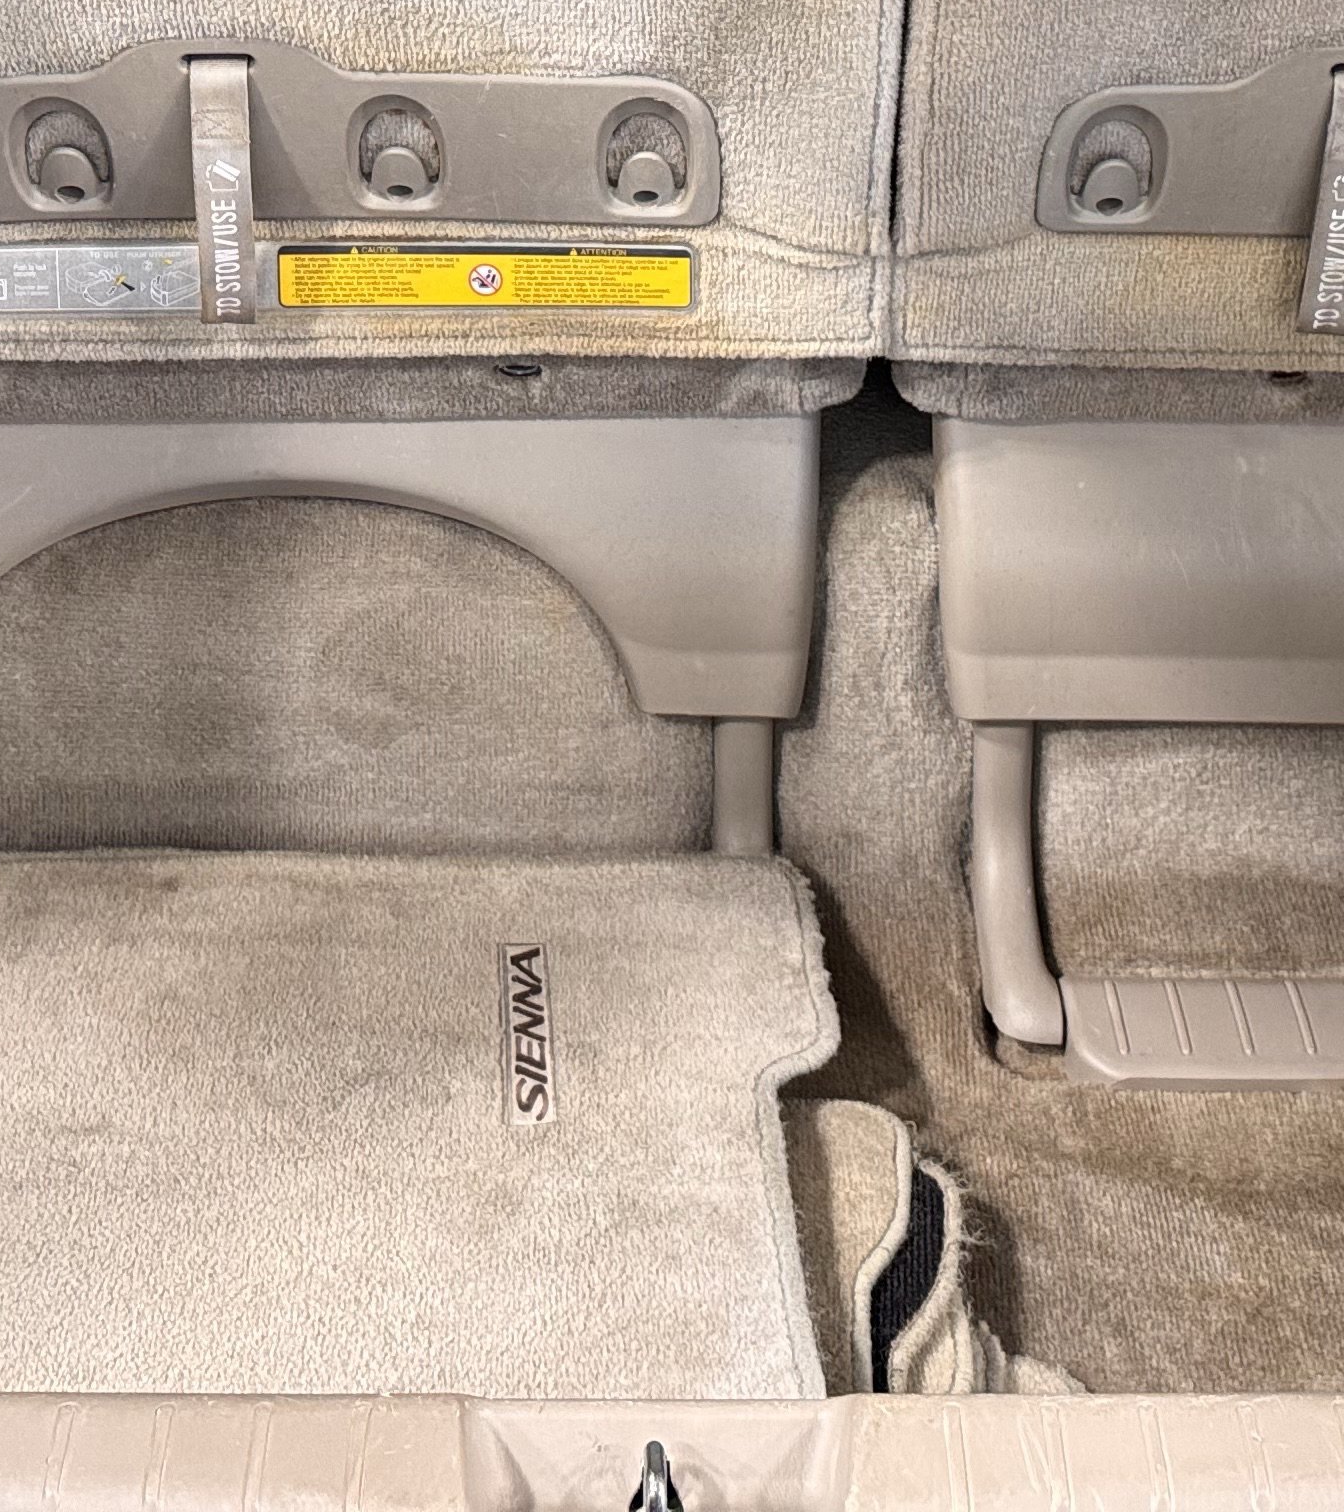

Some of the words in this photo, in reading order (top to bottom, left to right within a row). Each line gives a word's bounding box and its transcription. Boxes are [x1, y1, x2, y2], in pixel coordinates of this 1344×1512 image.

[210, 198, 242, 293] STOW/USE
[361, 246, 399, 254] CAUTION
[580, 248, 627, 256] ATTENTION
[216, 296, 242, 317] TO
[1313, 307, 1340, 330] TO
[509, 946, 549, 1122] SIENNA
